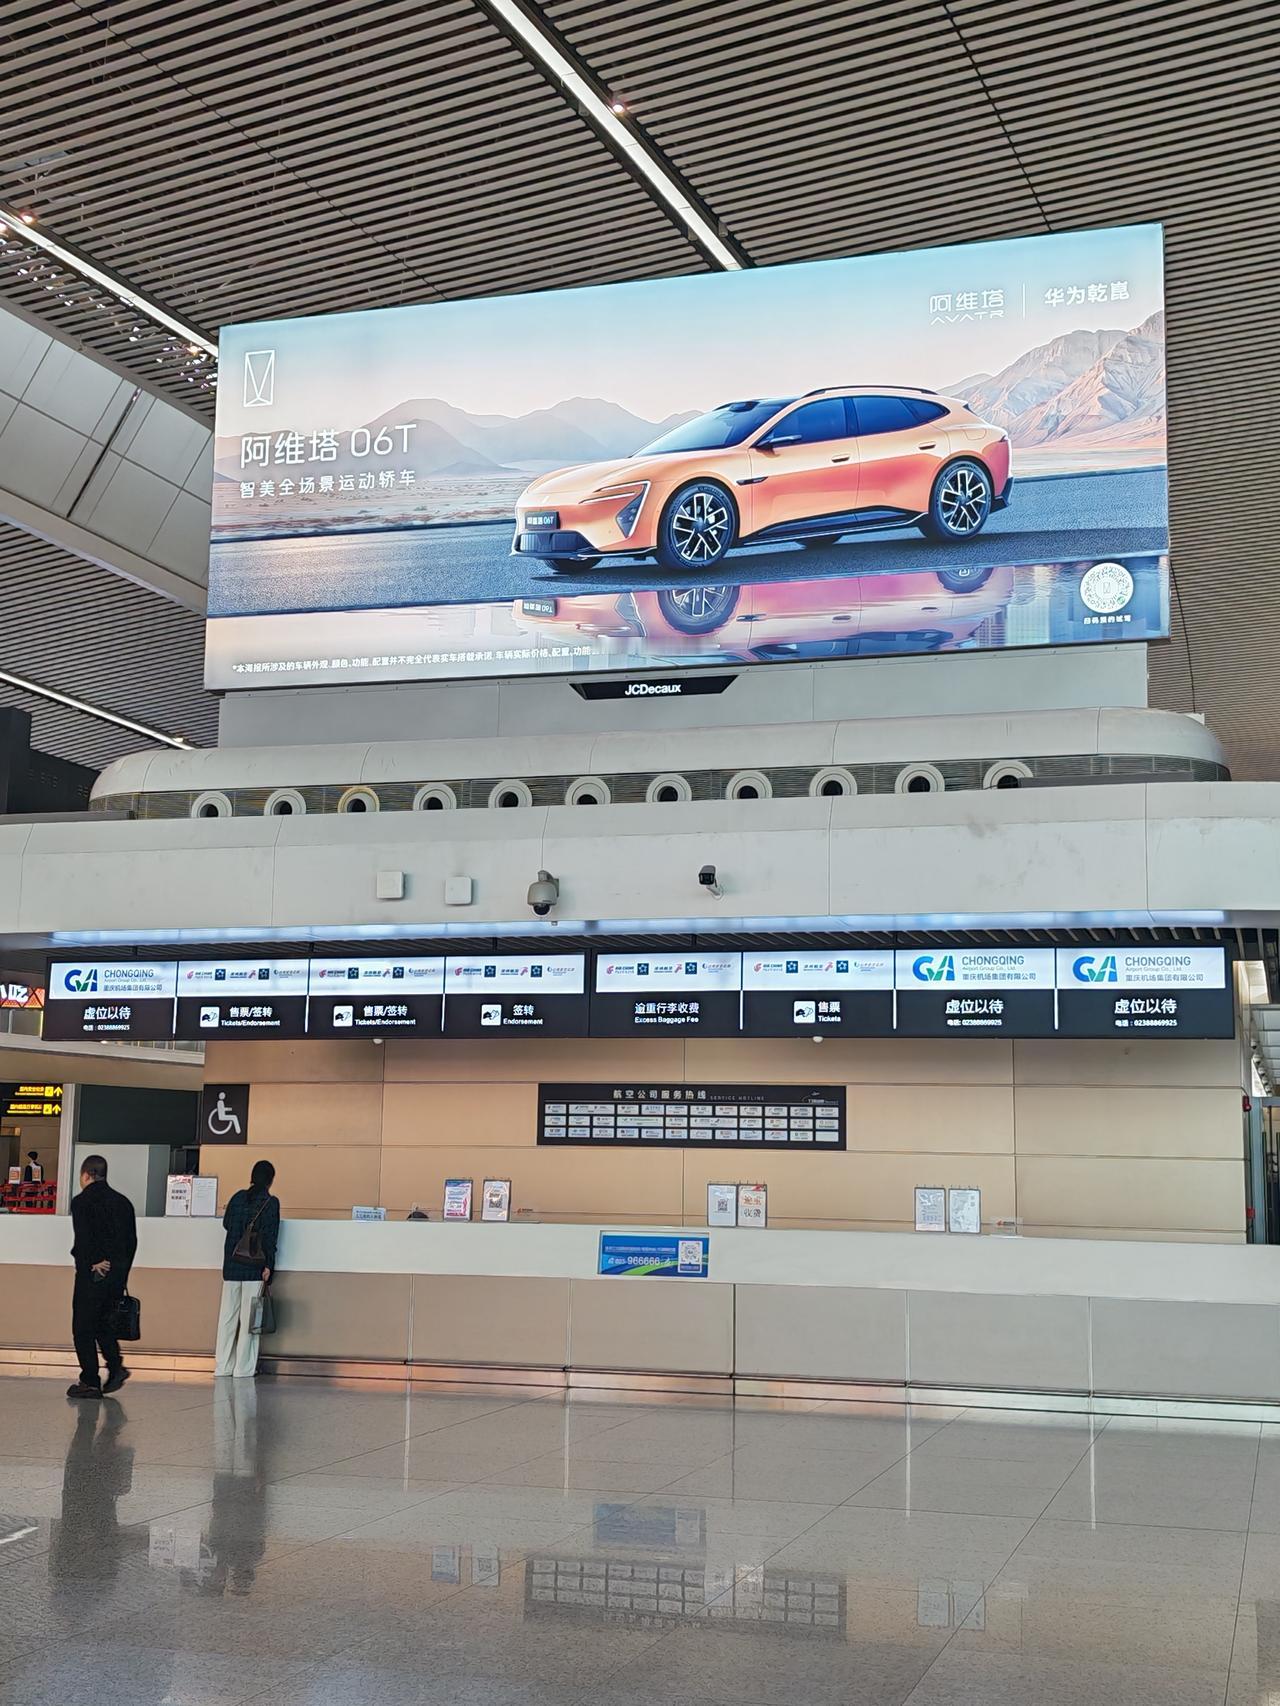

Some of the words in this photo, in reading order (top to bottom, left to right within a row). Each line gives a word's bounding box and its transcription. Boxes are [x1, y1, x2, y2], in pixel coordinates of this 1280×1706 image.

[929, 289, 1004, 313] 阿维塔
[240, 429, 340, 469] 阿维塔
[350, 423, 417, 457] 06T
[239, 469, 416, 499] 智美全场景运动轿车
[624, 683, 682, 696] JCDecaux
[962, 955, 1025, 966] CHONGQING
[1125, 956, 1192, 967] CHONGQING
[104, 969, 154, 978] CHONGQING
[1125, 973, 1204, 982] 重庆机场集团有限公司
[512, 1004, 535, 1016] 签转
[634, 1002, 700, 1014] 逾重行李收费
[818, 1001, 841, 1013] 售票
[945, 999, 1004, 1014] 虚位以待
[1114, 998, 1177, 1014] 虚位以待
[83, 1006, 131, 1020] 虚位以待
[818, 1015, 841, 1023] Tickets
[658, 1016, 686, 1024] Baggage
[613, 1089, 707, 1100] 航空公司服务热线
